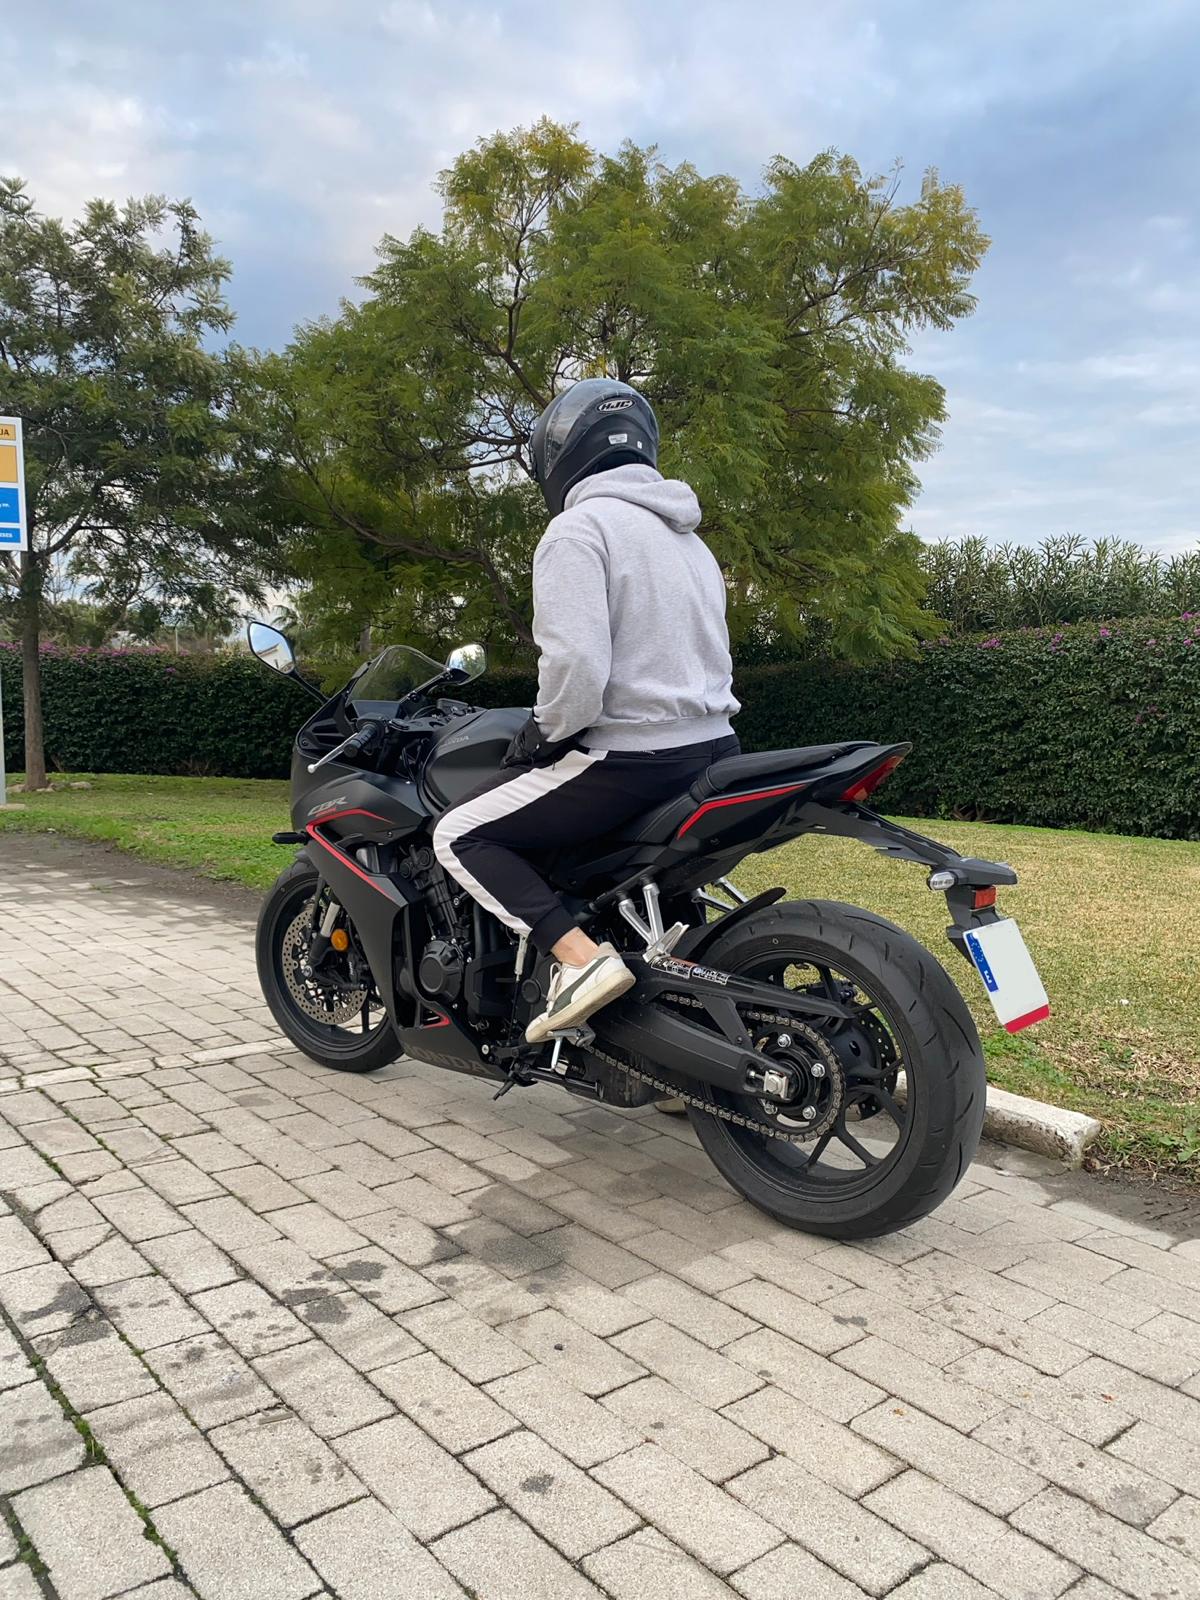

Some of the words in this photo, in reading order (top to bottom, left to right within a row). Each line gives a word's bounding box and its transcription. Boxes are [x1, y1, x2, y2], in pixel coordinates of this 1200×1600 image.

[601, 400, 631, 411] HJC
[307, 796, 348, 817] CBR
[983, 969, 993, 984] E
